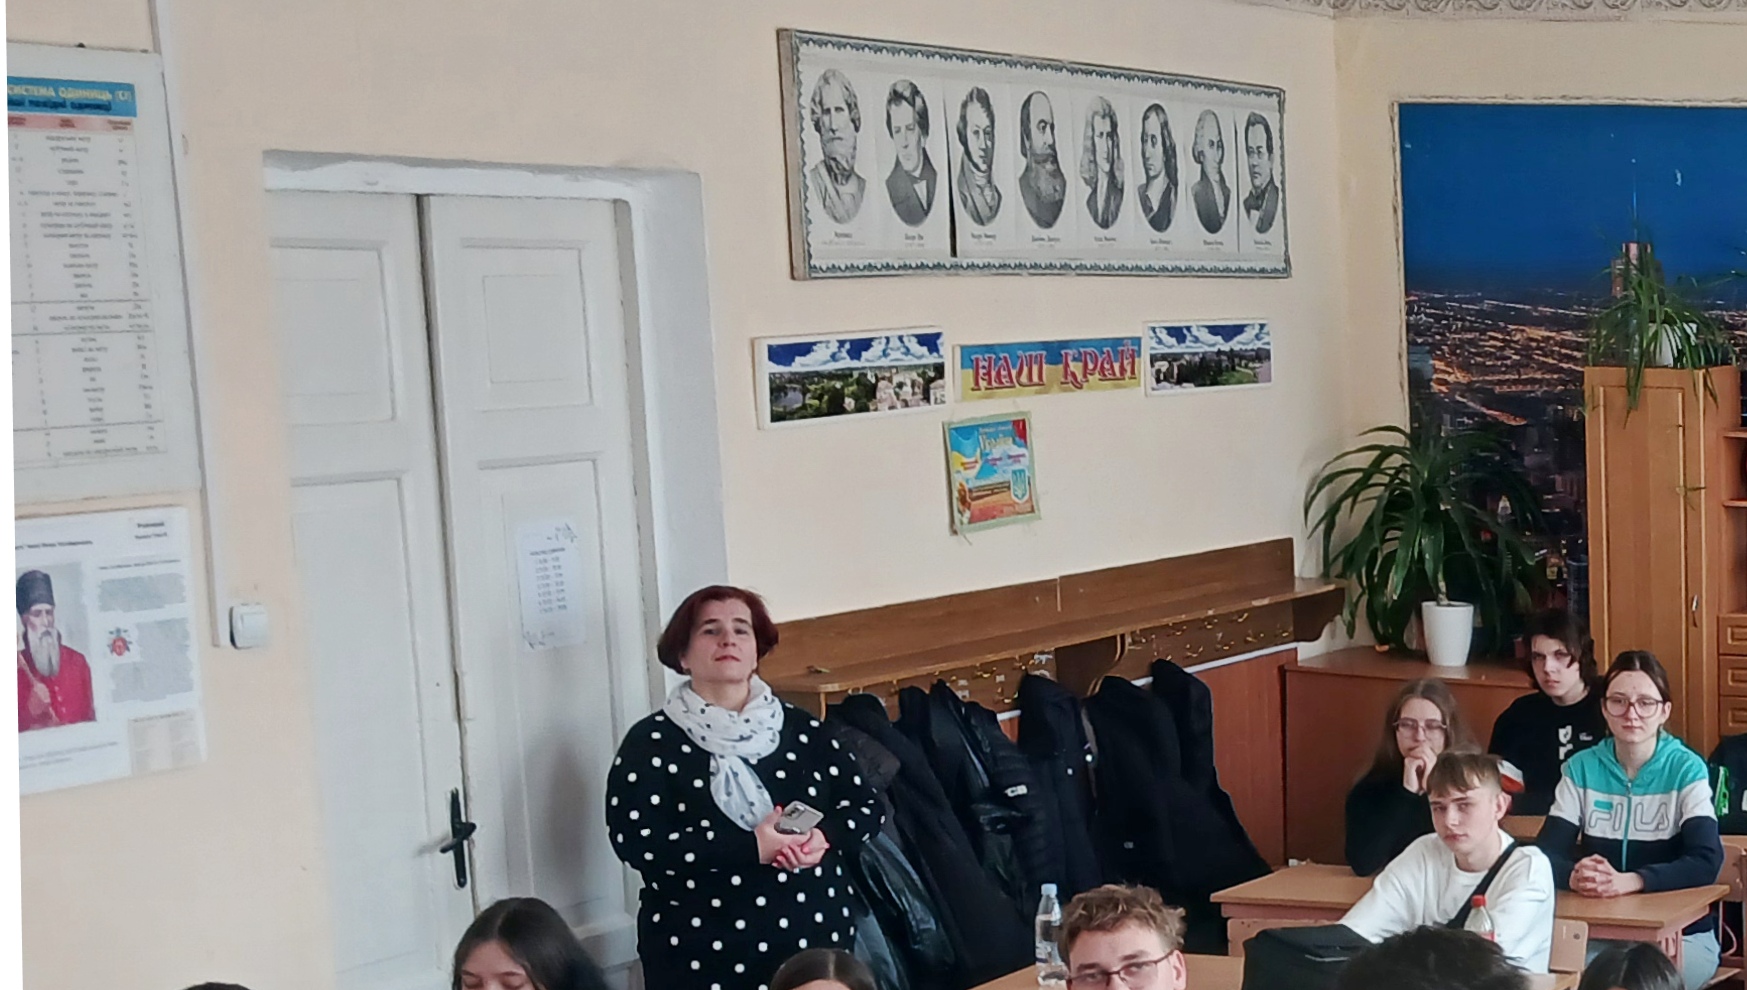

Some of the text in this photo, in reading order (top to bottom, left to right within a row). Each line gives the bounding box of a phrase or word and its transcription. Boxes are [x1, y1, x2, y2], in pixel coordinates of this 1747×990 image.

[971, 340, 1139, 391] НАШ КРАЙ
[1587, 799, 1670, 832] FILA
